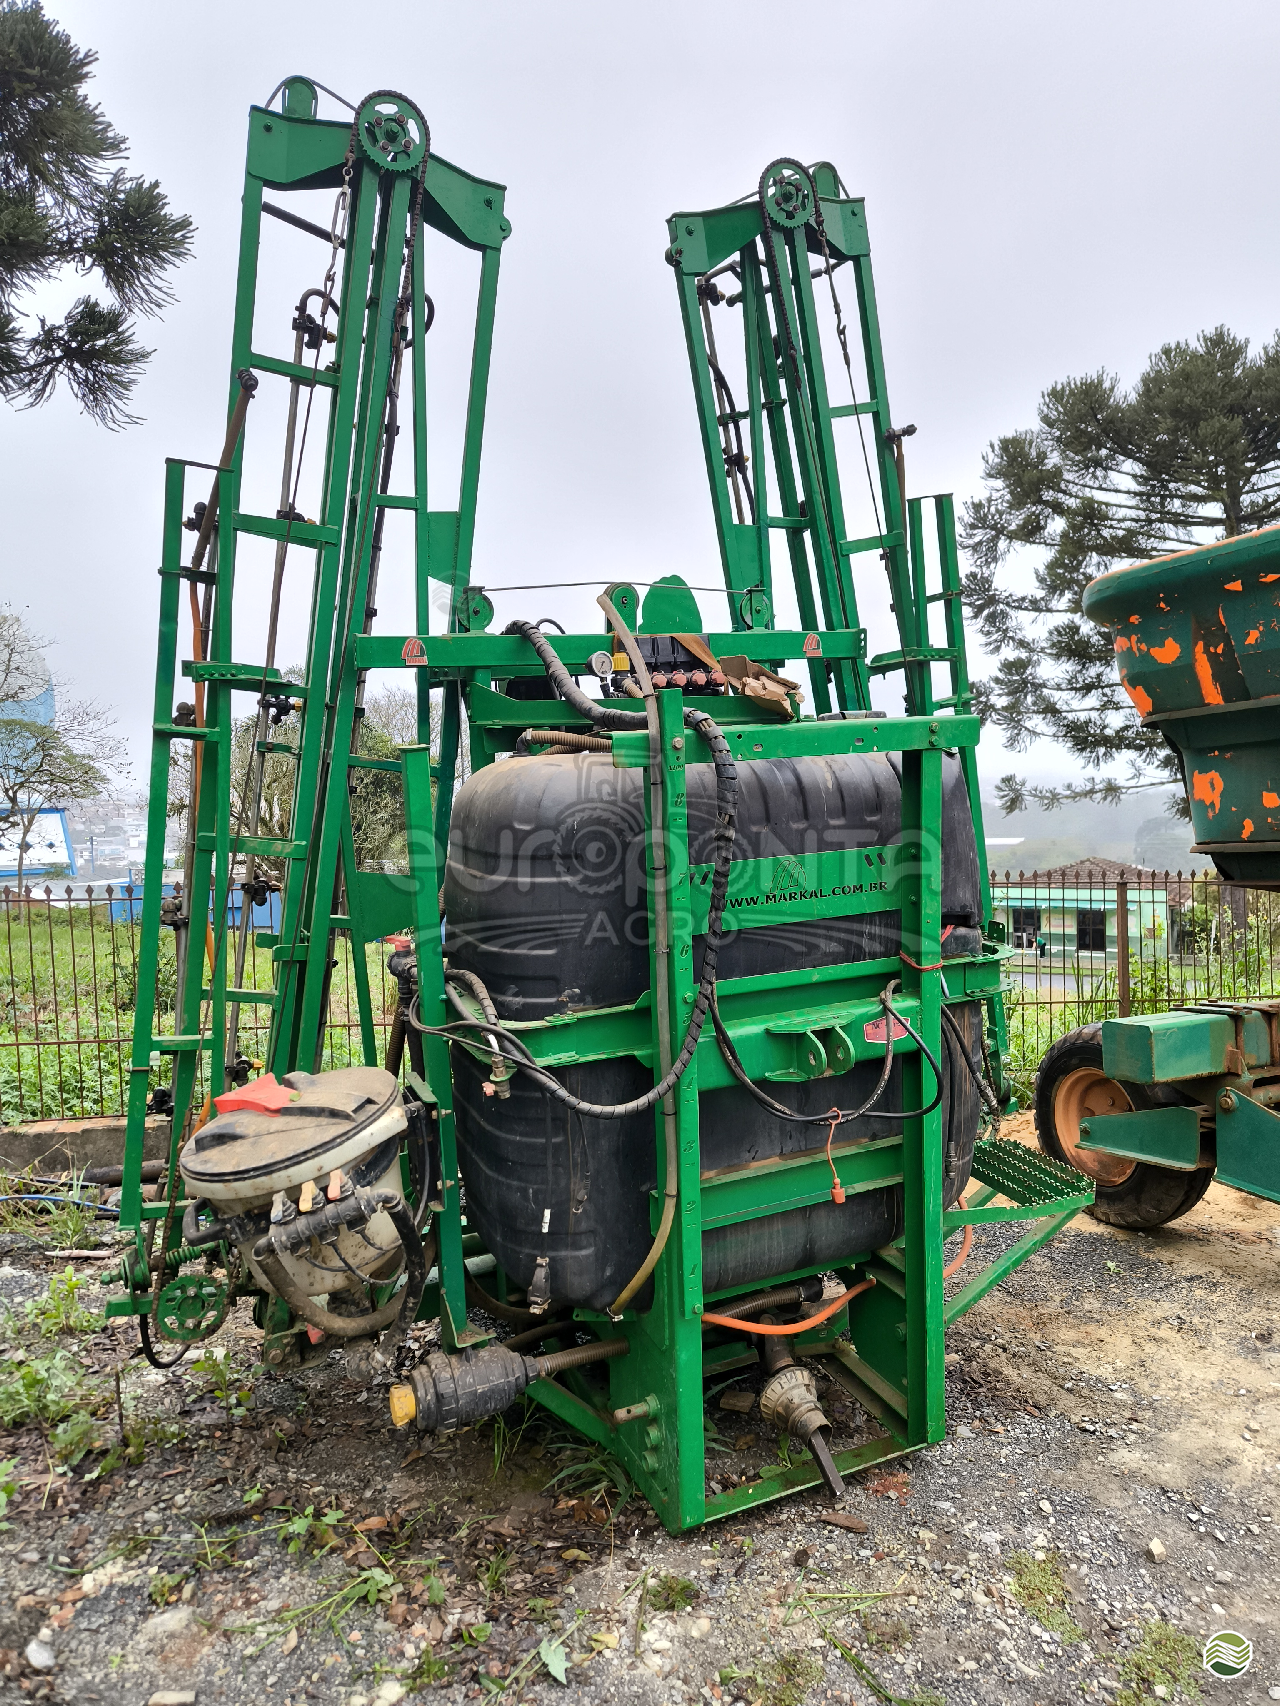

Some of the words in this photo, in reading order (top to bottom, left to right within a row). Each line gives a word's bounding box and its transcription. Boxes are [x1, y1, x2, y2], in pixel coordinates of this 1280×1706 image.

[674, 792, 685, 807] 8
[678, 872, 688, 886] 7
[725, 881, 888, 909] WW.MARKAL.COM.BR
[680, 944, 690, 958] 6
[683, 1011, 693, 1026] 5
[682, 1076, 694, 1090] 4
[683, 1139, 695, 1154] 3
[685, 1199, 697, 1214] 2
[688, 1263, 698, 1277] 1
